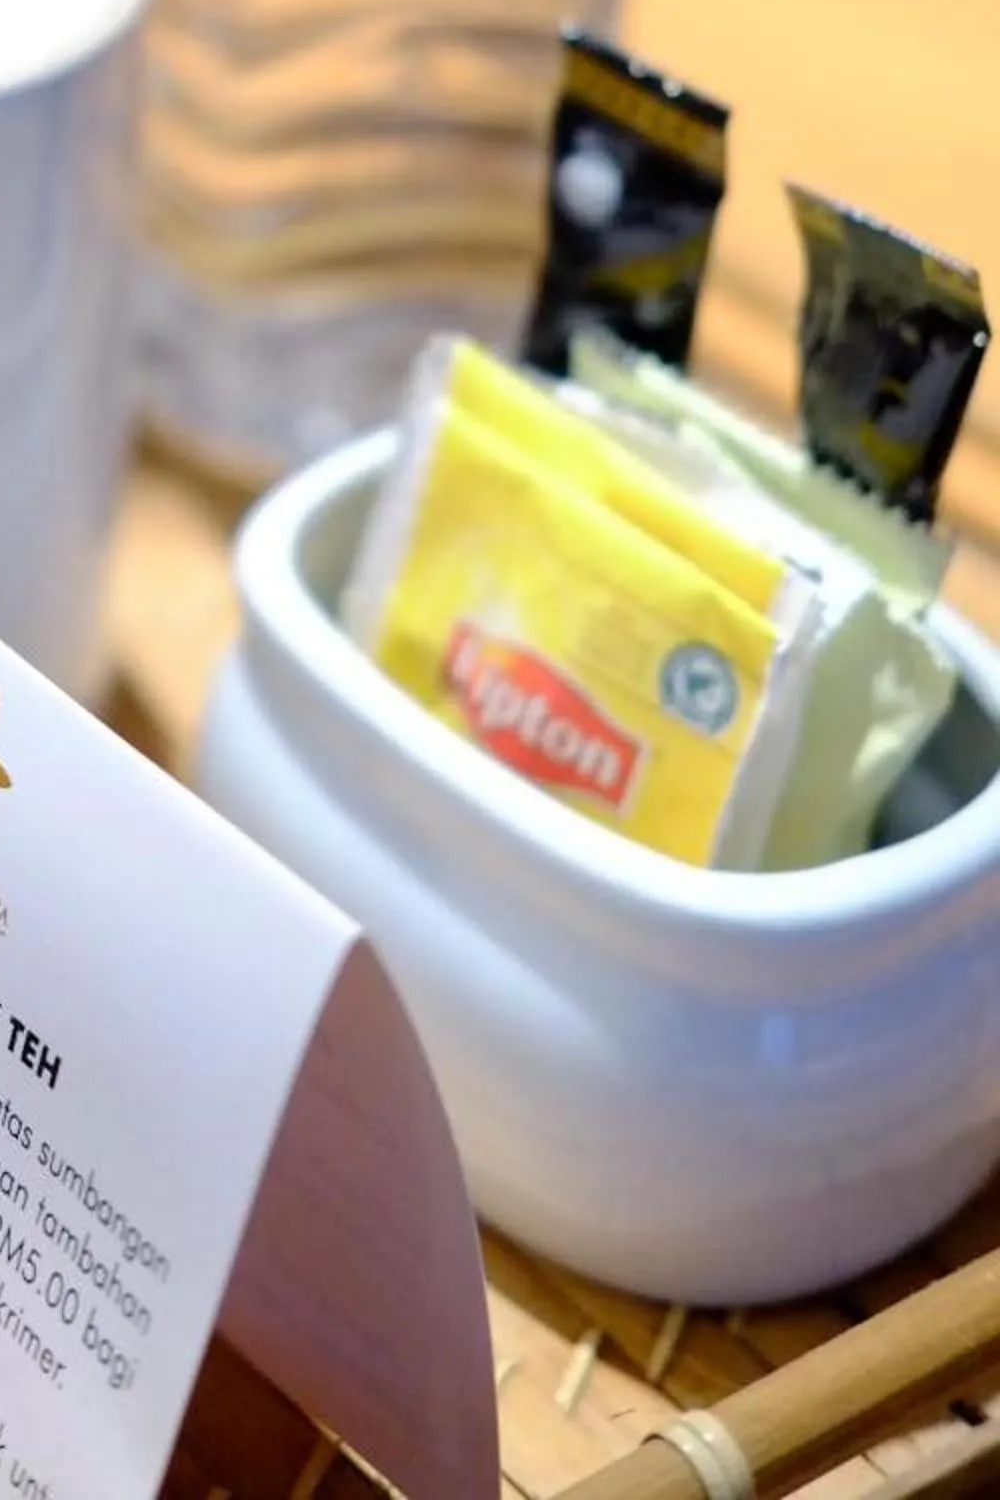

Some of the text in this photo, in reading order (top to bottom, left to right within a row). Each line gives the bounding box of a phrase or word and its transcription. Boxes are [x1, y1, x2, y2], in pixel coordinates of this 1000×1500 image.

[7, 1016, 62, 1090] TEH
[35, 1197, 154, 1337] tambahan
[37, 1141, 171, 1284] sumbangan
[81, 1306, 141, 1392] bagi
